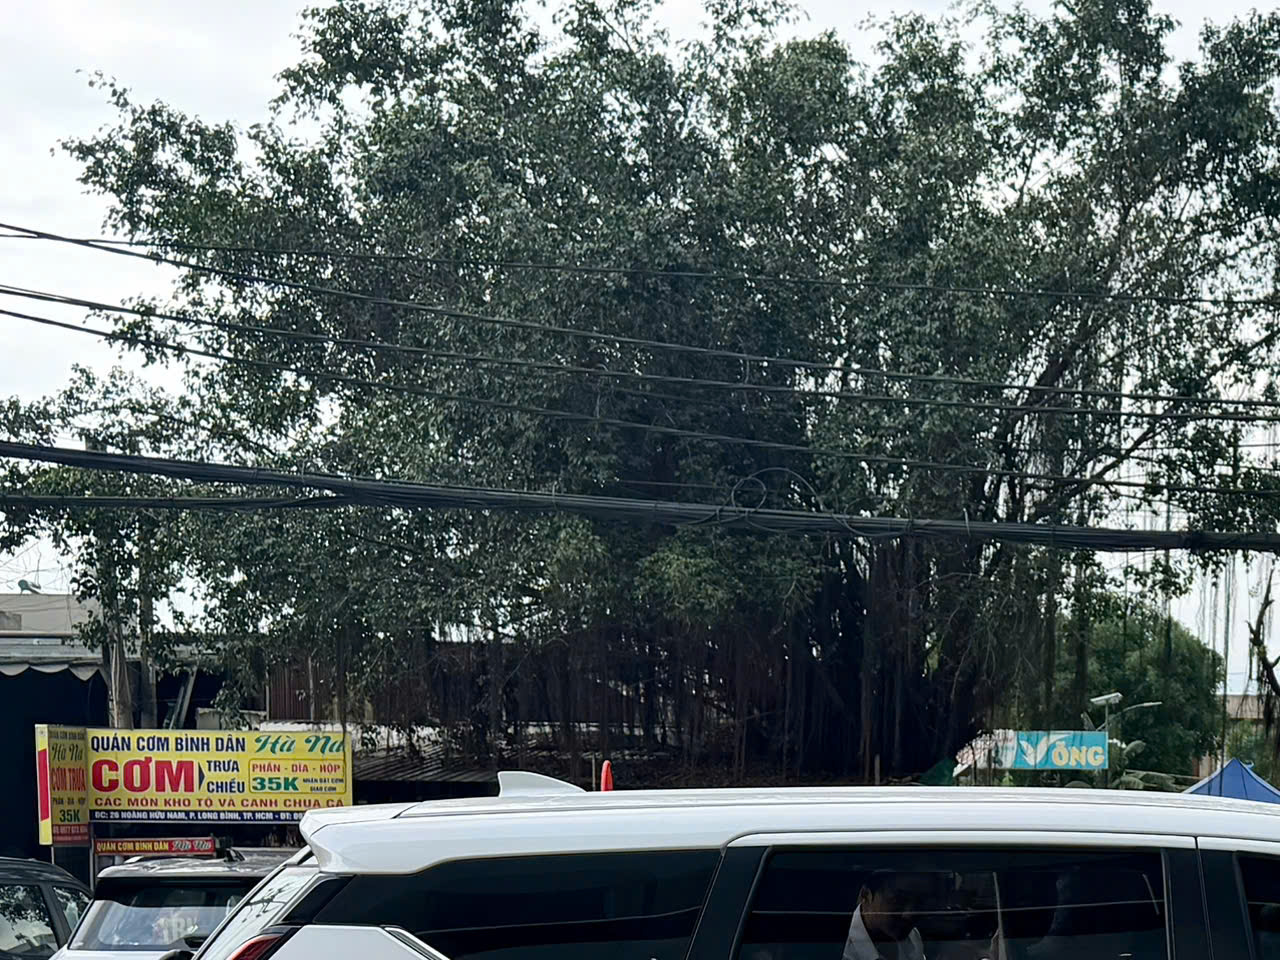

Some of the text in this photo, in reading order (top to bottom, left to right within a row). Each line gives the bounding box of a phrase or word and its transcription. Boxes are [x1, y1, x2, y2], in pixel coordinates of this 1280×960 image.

[91, 733, 131, 752] QUÁN
[136, 735, 170, 752] CƠM
[175, 733, 210, 752] BÌNH
[215, 734, 246, 752] DÂN
[92, 756, 240, 793] CƠM TRƯA
[252, 777, 299, 791] 35K
[94, 797, 122, 808] CÁC
[164, 797, 191, 808] KHO
[219, 796, 236, 808] VÀ
[240, 798, 278, 808] CANH
[284, 798, 321, 808] CHUA
[59, 809, 80, 823] 35K
[255, 812, 273, 820] HCM
